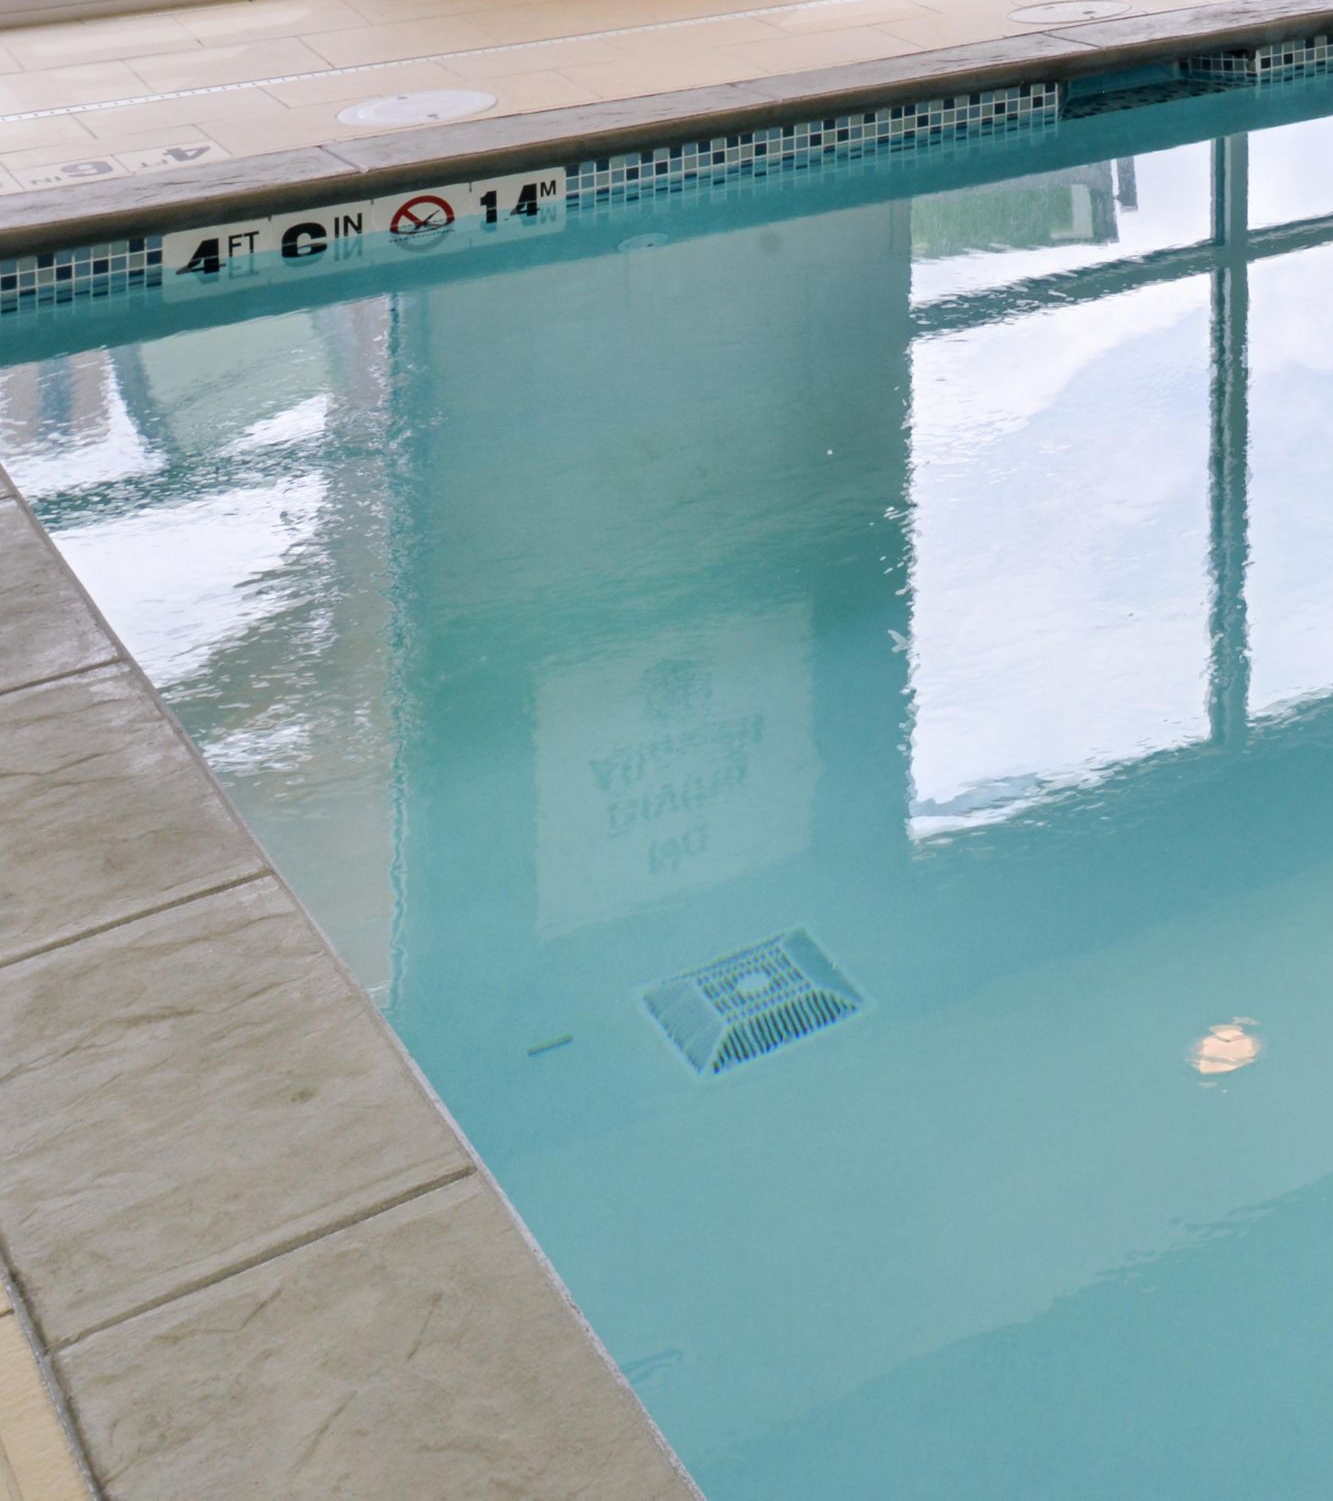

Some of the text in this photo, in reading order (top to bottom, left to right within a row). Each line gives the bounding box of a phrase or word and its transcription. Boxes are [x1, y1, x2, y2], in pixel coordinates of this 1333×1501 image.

[176, 237, 226, 275] 4
[228, 231, 260, 258] FT
[334, 212, 363, 239] IN
[540, 180, 557, 197] M
